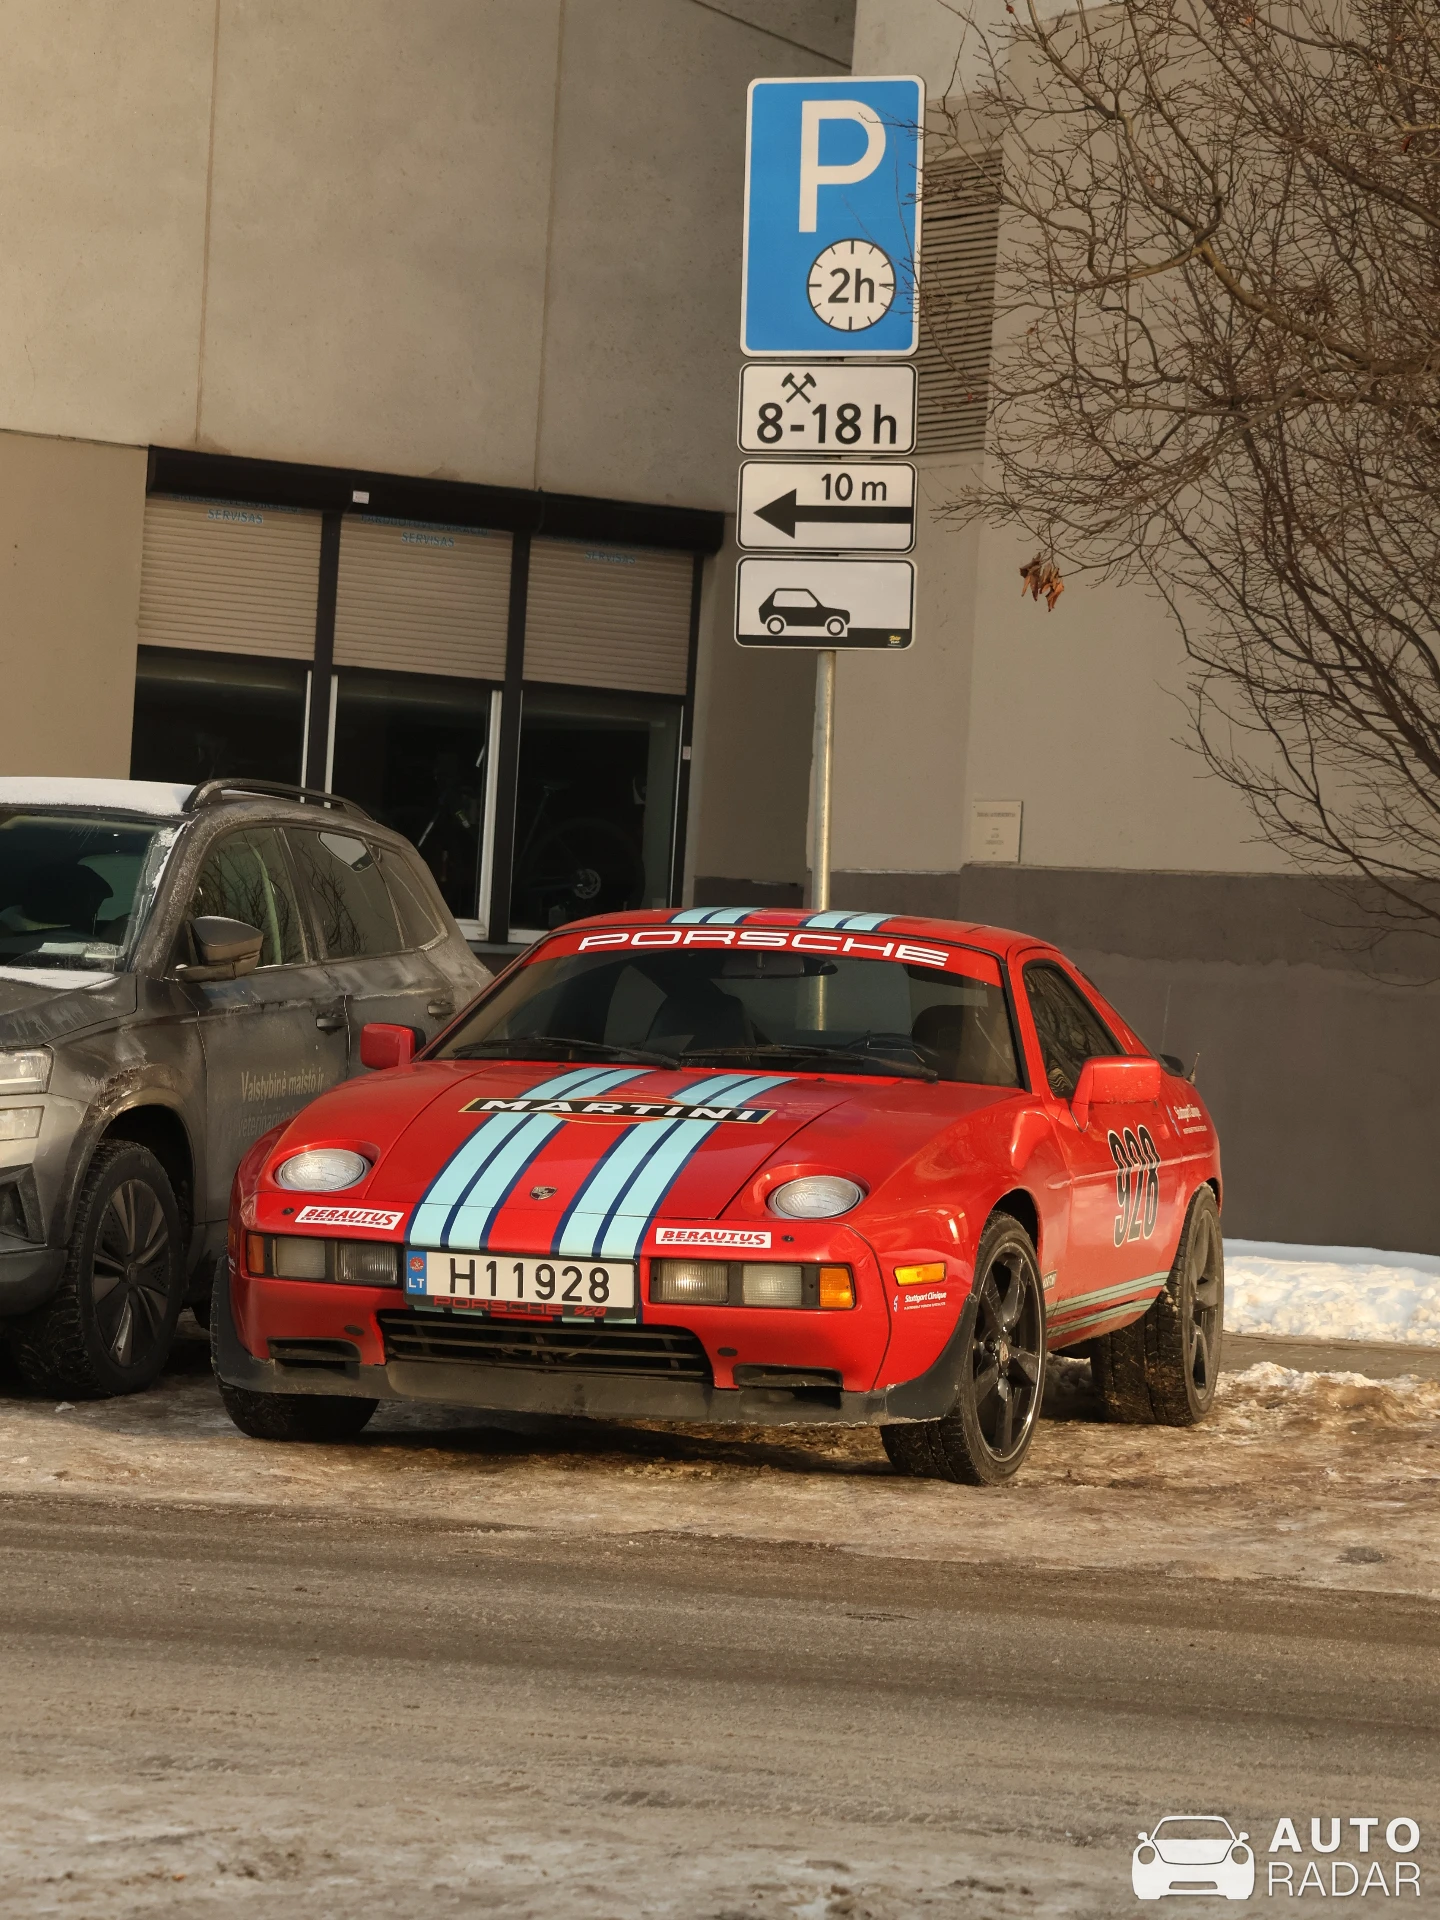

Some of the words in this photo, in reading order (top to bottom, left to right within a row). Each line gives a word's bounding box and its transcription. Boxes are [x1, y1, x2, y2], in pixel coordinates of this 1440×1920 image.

[799, 100, 886, 232] P
[827, 267, 875, 303] 2h
[821, 472, 853, 501] 10
[861, 481, 887, 501] m
[207, 509, 263, 524] SERVISAS
[401, 531, 455, 547] SERVISAS
[577, 930, 950, 967] PORSCHE
[479, 1099, 758, 1121] MARTINI
[1107, 1124, 1161, 1248] 928
[304, 1208, 398, 1226] BERAUTUS
[662, 1230, 766, 1245] BERAUTUS
[408, 1277, 425, 1289] LT
[450, 1257, 610, 1303] H11928
[433, 1295, 563, 1315] PORSCHE
[573, 1306, 608, 1317] 928
